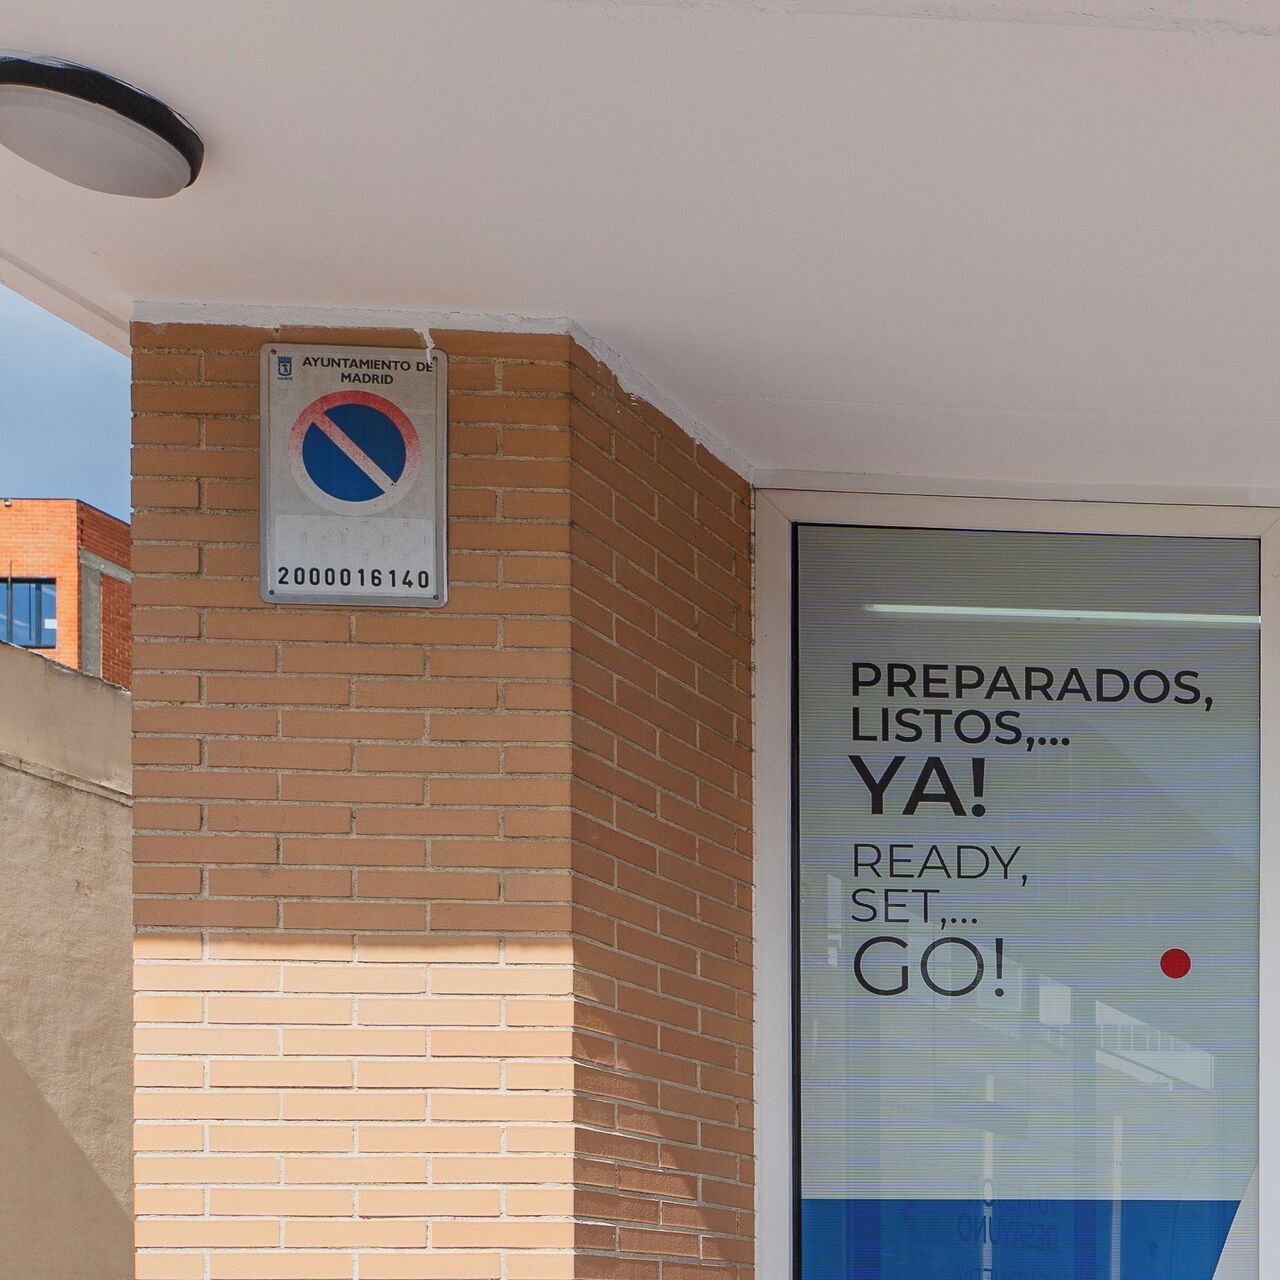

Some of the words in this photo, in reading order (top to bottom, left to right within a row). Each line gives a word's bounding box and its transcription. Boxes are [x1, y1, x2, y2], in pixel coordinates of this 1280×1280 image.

[302, 356, 411, 372] AYUNTAMIENTO
[416, 361, 434, 372] DE
[340, 371, 394, 385] MADRID
[277, 566, 430, 589] 2000016140
[851, 661, 1215, 713] PREPARADOS,
[851, 705, 1071, 752] LISTOS,...
[847, 754, 988, 818] YA!
[852, 843, 1030, 888] READY,
[850, 888, 979, 931] SET,...
[853, 935, 1006, 998] GO!
